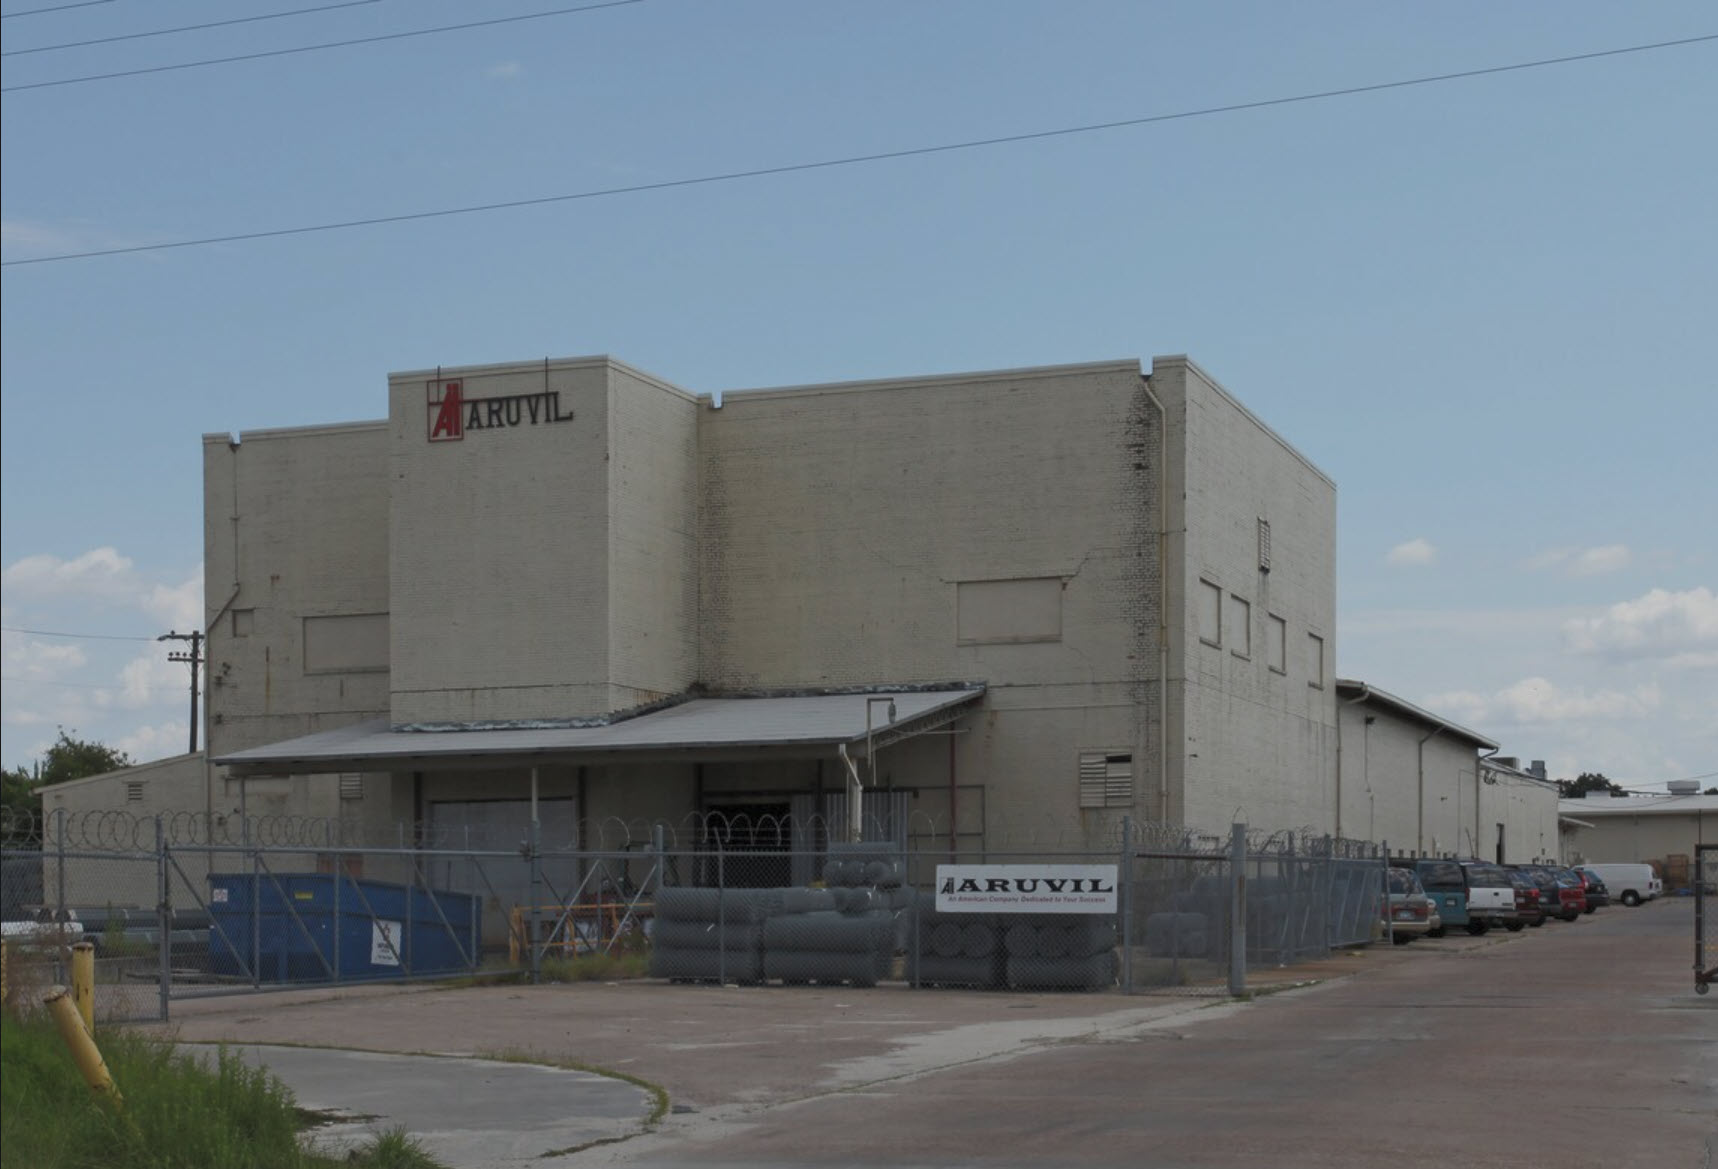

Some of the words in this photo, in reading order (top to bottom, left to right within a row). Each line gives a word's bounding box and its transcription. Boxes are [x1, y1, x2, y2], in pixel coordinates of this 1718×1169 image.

[465, 391, 574, 430] ARUVIL
[956, 878, 1113, 893] ARUVIL
[989, 896, 1019, 904] Company
